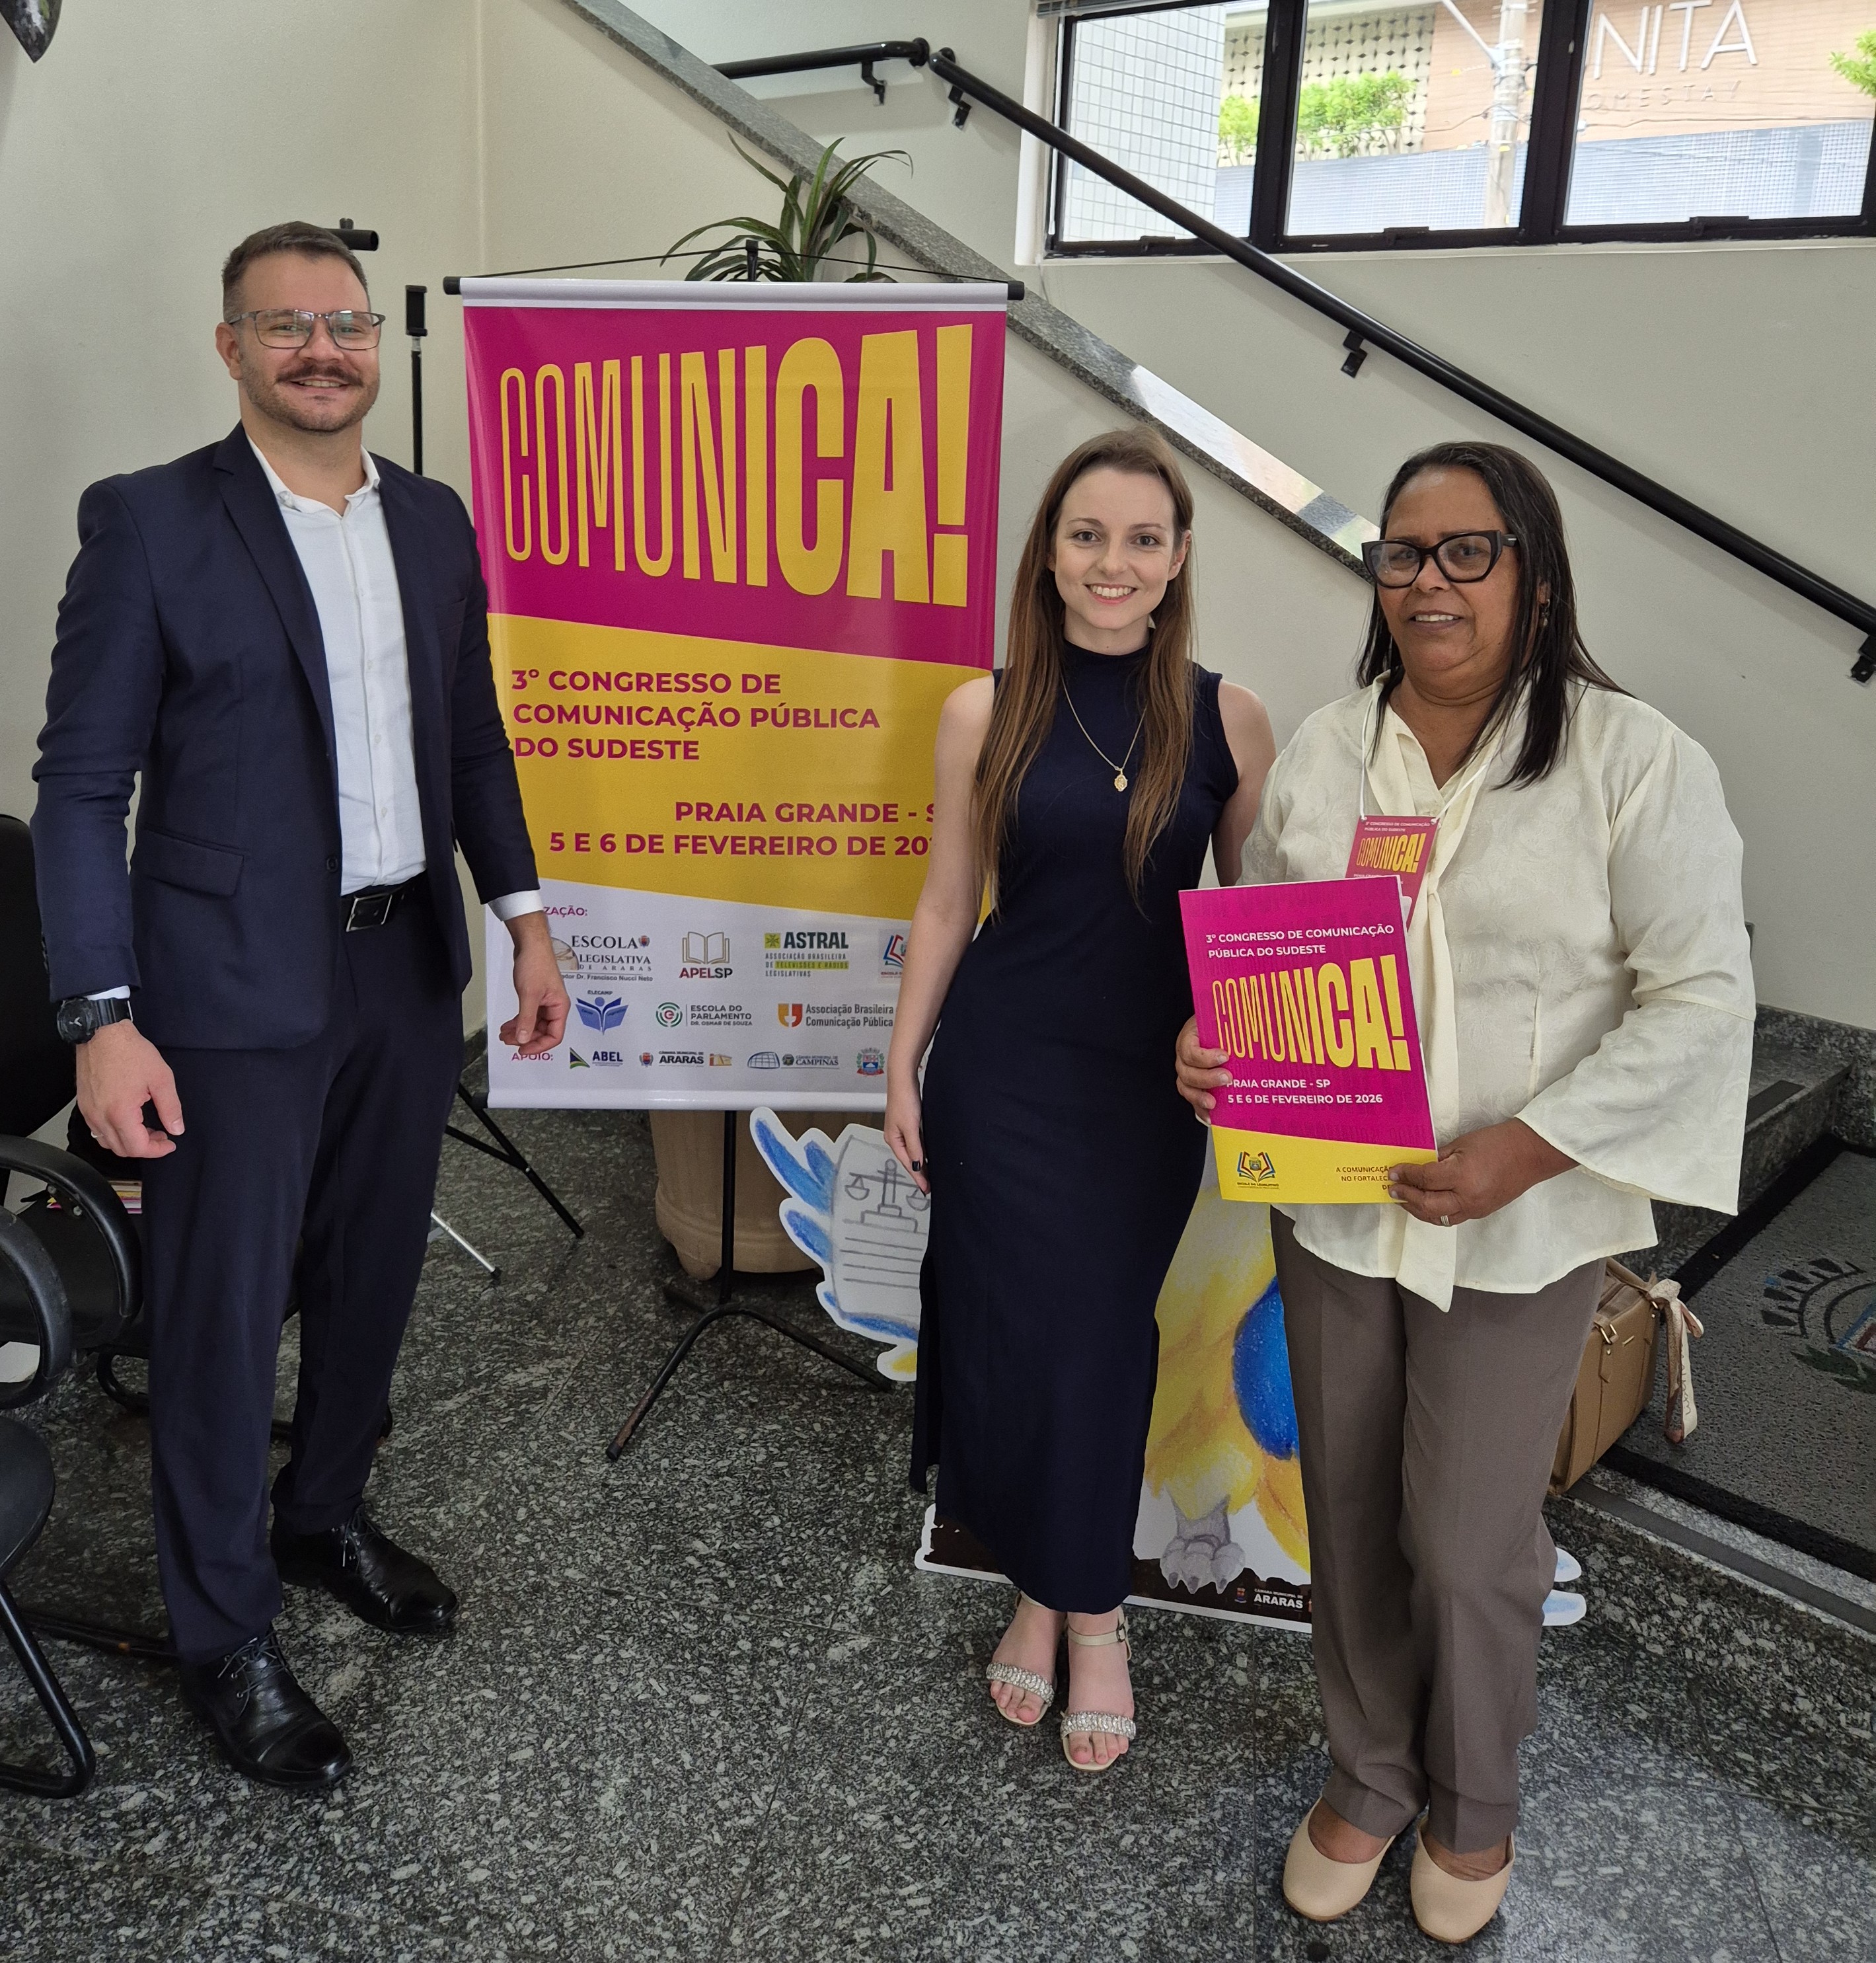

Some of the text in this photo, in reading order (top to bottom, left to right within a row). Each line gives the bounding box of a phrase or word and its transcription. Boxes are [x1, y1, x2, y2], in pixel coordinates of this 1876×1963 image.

[1594, 0, 1758, 79] NITA
[1587, 80, 1742, 110] OMESTAY
[500, 323, 973, 607] COMUNICA!
[548, 670, 732, 694] CONGRESSO
[741, 673, 781, 694] DE
[513, 702, 881, 732] COMUNICAÇÃO PÚBLICA
[515, 737, 700, 760] DO SUDESTE
[675, 801, 767, 822] PRAIA
[775, 802, 899, 823] GRANDE
[550, 831, 932, 856] 5 E 6 DE FEVEREIRO DE 20
[1357, 833, 1427, 873] COMUNICA!
[543, 905, 587, 918] ZAÇÃO:
[783, 931, 849, 949] ASTRAL
[1219, 931, 1285, 943] CONGRESSO
[1287, 930, 1304, 940] DE
[1305, 923, 1395, 938] COMUNICAÇÃO
[572, 935, 638, 949] ESCOLA
[579, 954, 651, 964] LEGISLATIVA
[1208, 944, 1327, 958] PÚBLICA DO SUDESTE
[679, 967, 733, 979] APELSP
[806, 1003, 894, 1016] Associação Brasileira
[1212, 954, 1411, 1071] COMUNICA!
[806, 1016, 893, 1029] Comunicação Pública
[592, 1050, 623, 1062] ABEL
[659, 1055, 704, 1064] ARARAS
[1226, 1079, 1259, 1088] PRAIA
[1260, 1079, 1307, 1088] GRANDE
[1316, 1079, 1331, 1088] SP
[1228, 1094, 1383, 1104] 5 E 6 DE FEVEREIRO DE 2026
[1254, 1594, 1304, 1609] ARARAS
